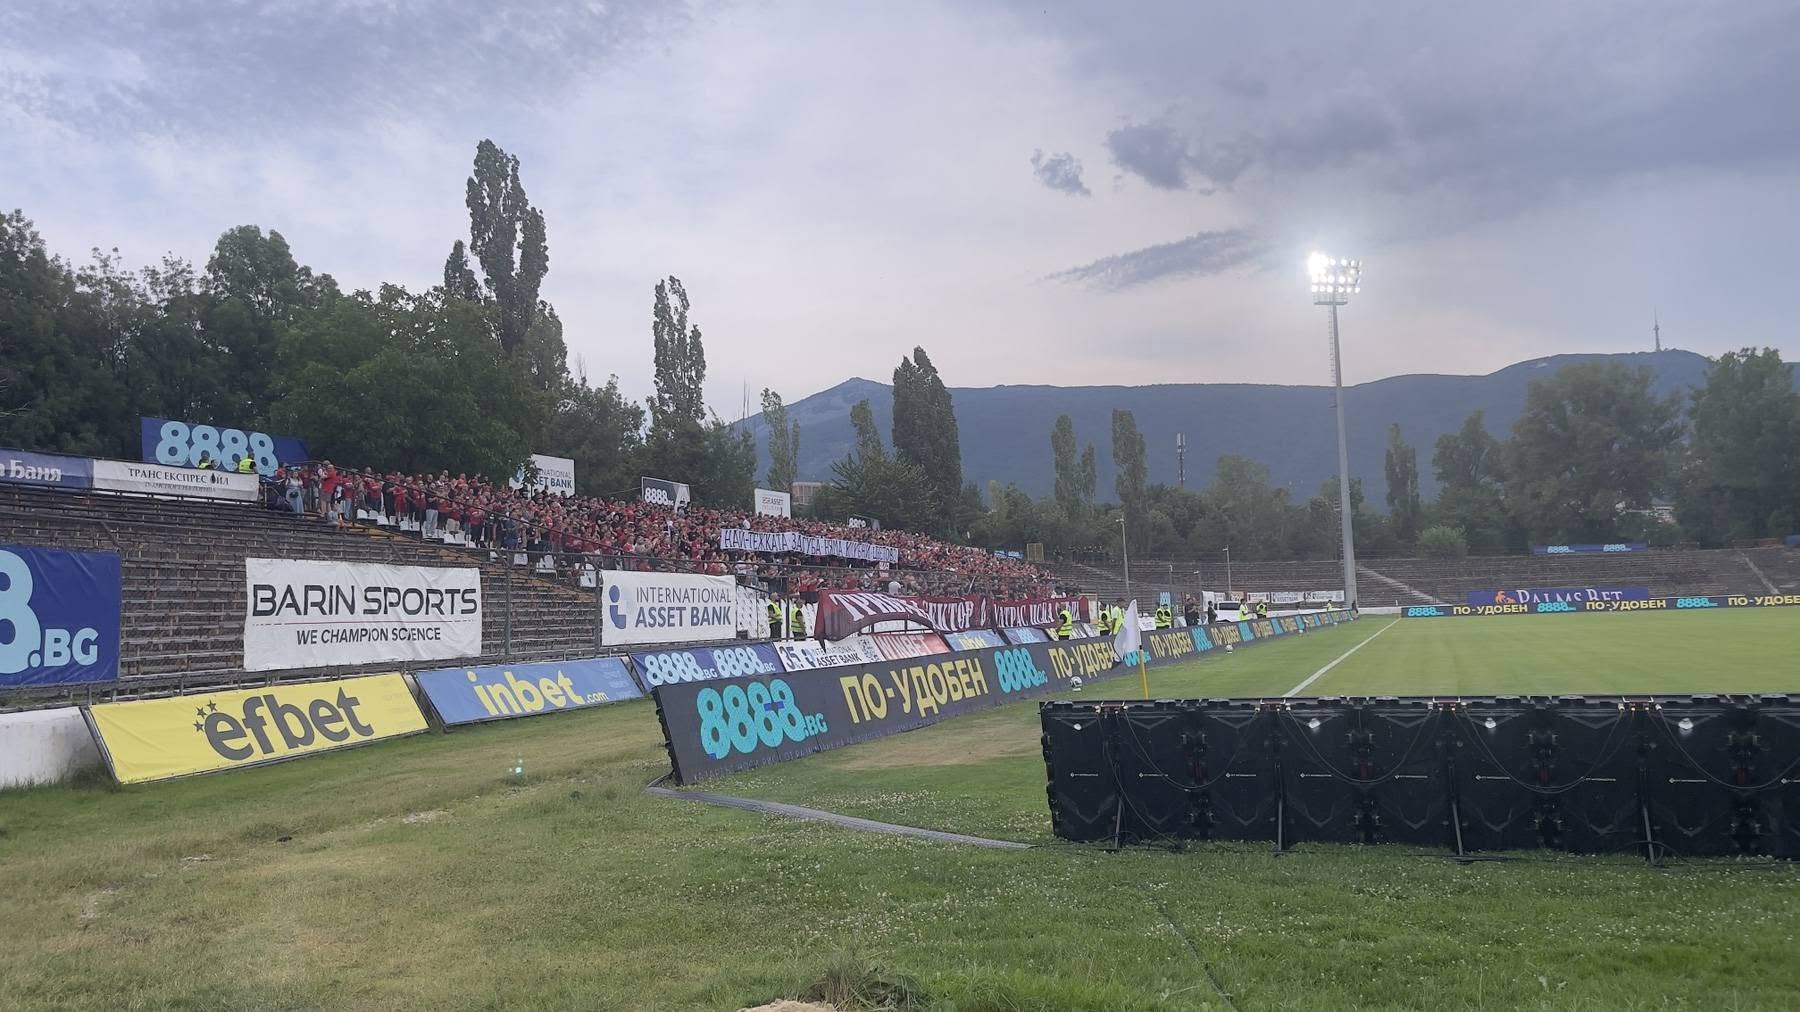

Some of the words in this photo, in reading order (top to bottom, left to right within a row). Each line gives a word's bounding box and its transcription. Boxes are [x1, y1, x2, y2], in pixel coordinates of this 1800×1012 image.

[156, 421, 278, 477] 8888
[10, 459, 62, 481] Баня
[128, 467, 163, 480] ТРАНС
[164, 471, 207, 484] ЕКСПРЕС
[550, 477, 572, 488] BANK
[252, 584, 355, 617] BARIN
[363, 586, 478, 616] SPORTS
[636, 586, 732, 603] INTERNATIONAL
[1516, 589, 1582, 603] PALMS
[1453, 604, 1528, 615] ПО-УДОБЕН
[1586, 600, 1666, 611] ПО-УДОБЕН
[635, 606, 686, 628] ASSET
[690, 606, 732, 627] BANK
[297, 629, 319, 645] WE
[321, 627, 389, 644] CHAMPION
[390, 626, 442, 643] SCIENCE
[816, 655, 842, 667] ASSET
[841, 652, 862, 664] BANK
[1048, 642, 1116, 679] ПО-УДОБЕН
[839, 658, 989, 724] ПО-УДОБЕН
[204, 687, 375, 761] efbet
